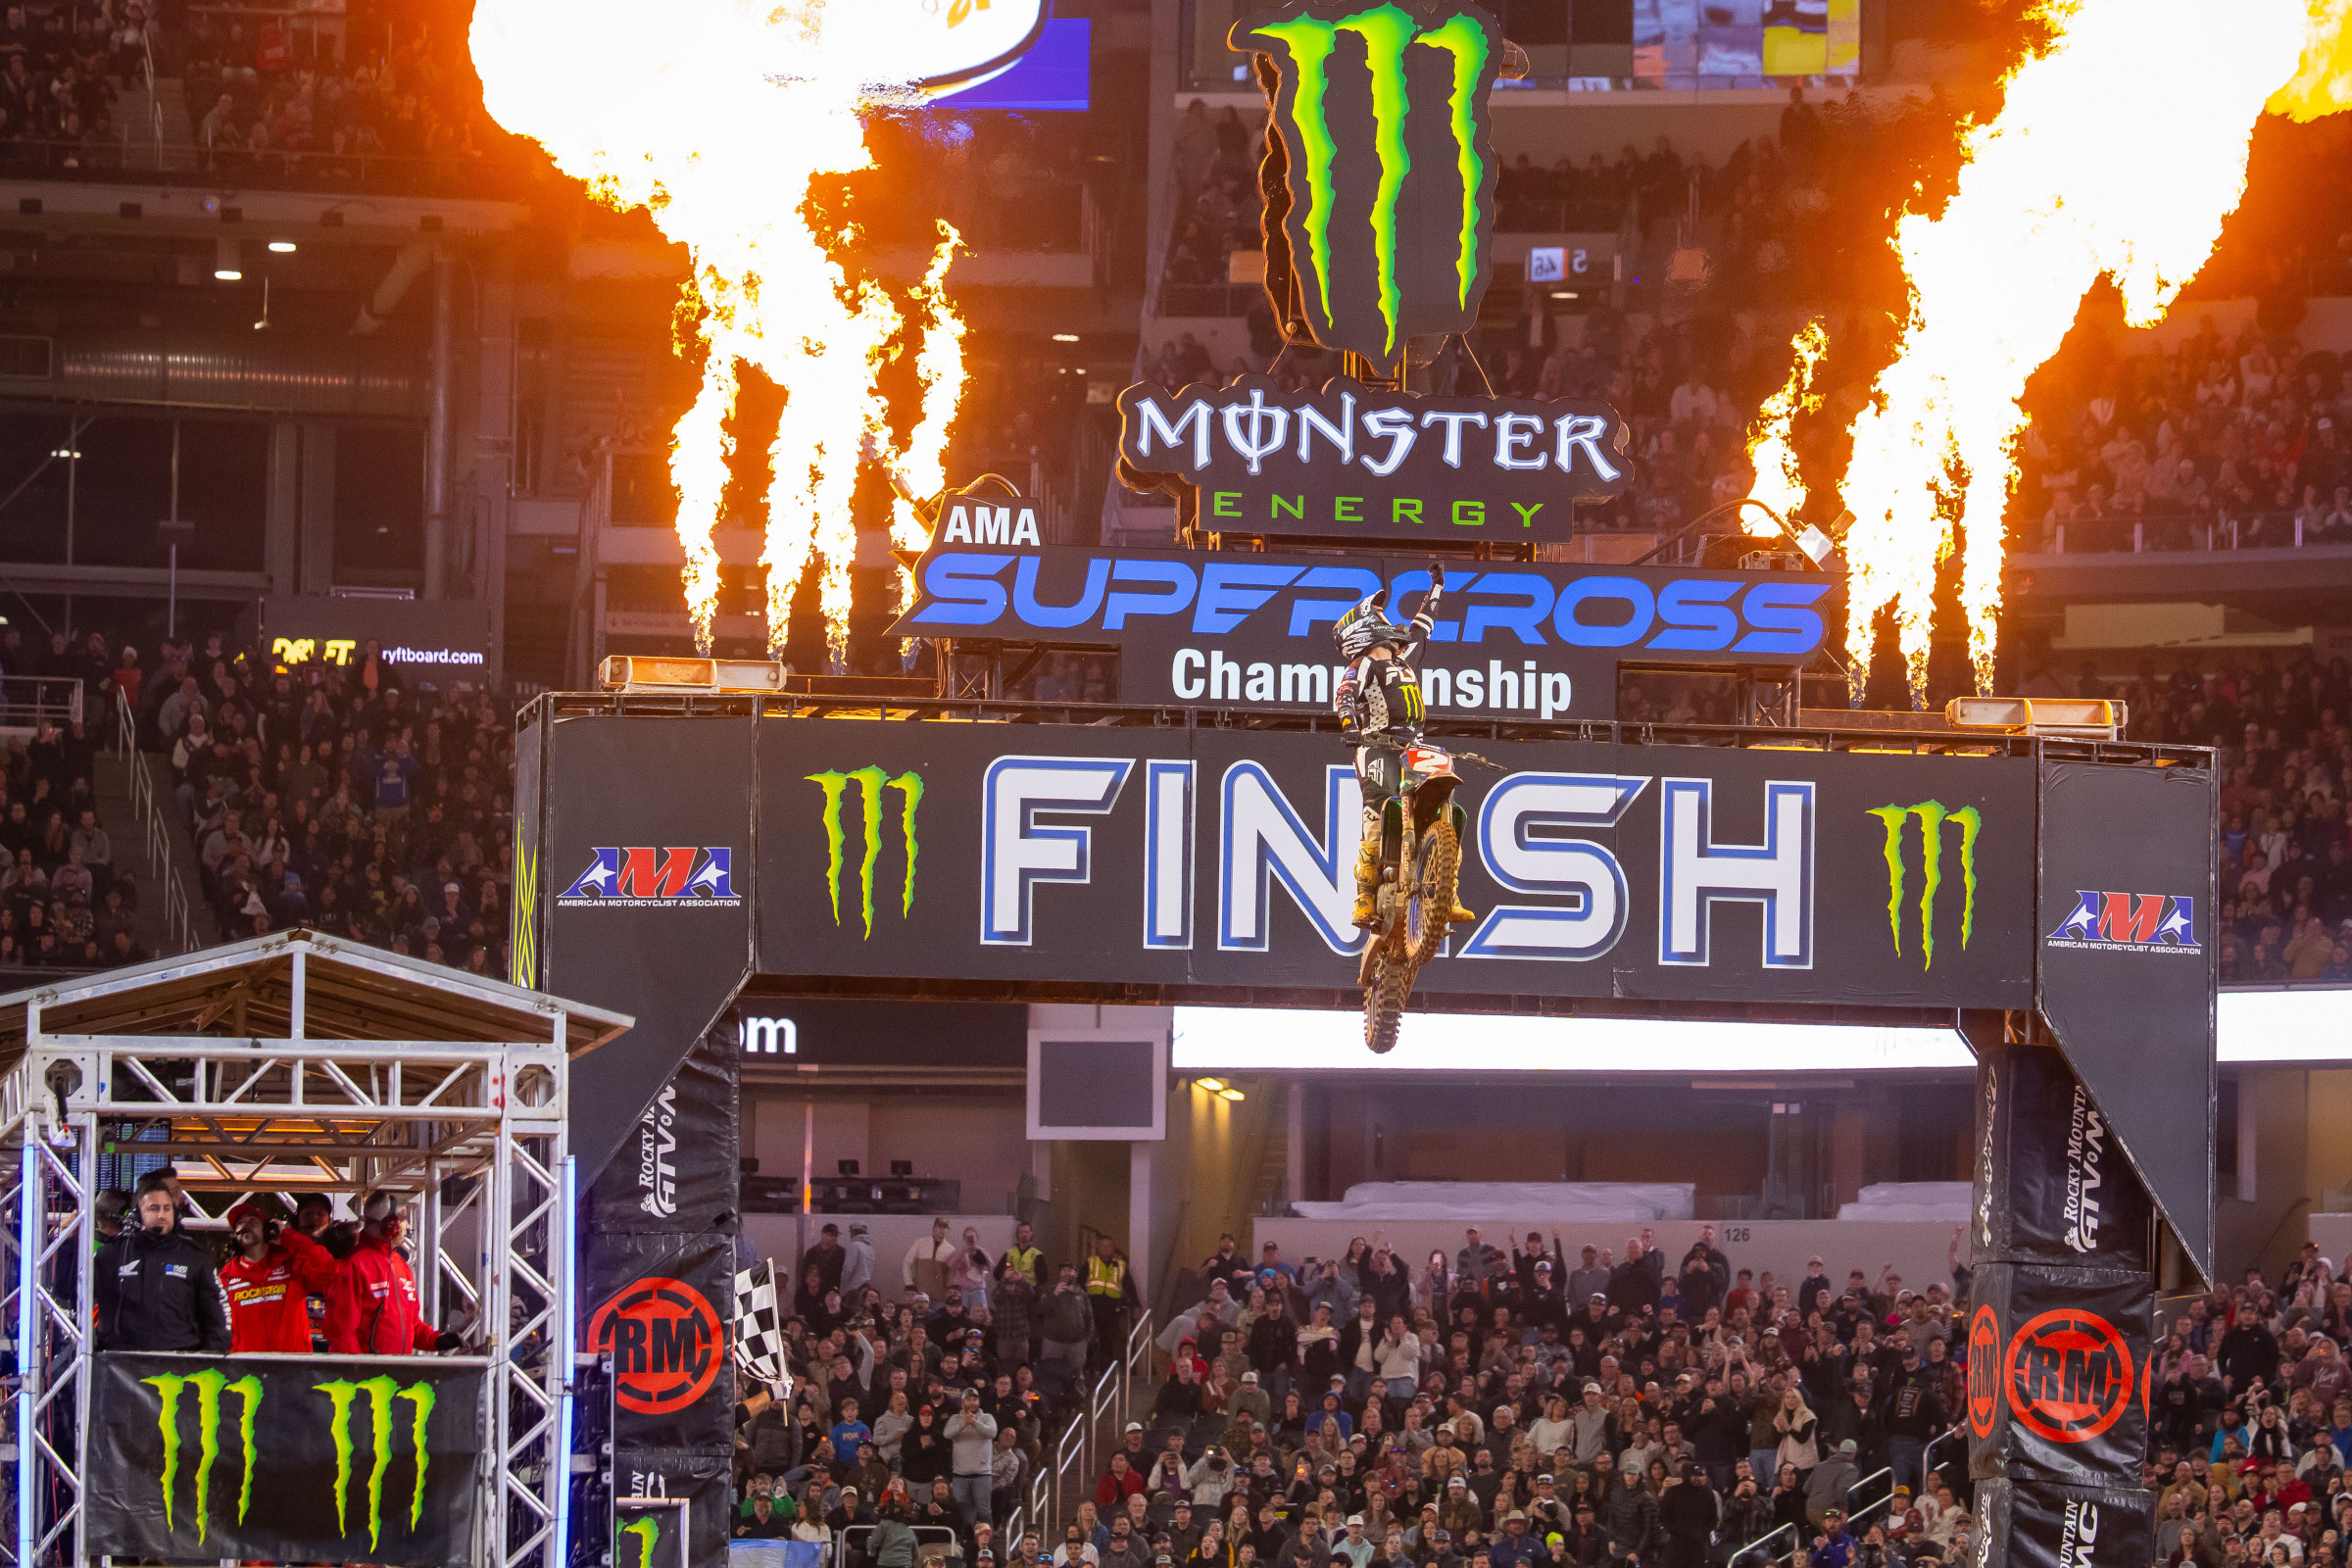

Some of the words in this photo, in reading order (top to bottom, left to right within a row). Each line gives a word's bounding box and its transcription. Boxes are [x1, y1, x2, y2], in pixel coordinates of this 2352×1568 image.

[1135, 388, 1622, 483] MONSTER
[944, 505, 1041, 547] AMA
[1213, 491, 1544, 527] ENERGY
[1413, 750, 1448, 773] 2
[1364, 809, 1380, 822] FLY
[555, 846, 743, 899] AMA
[980, 755, 1816, 970] FINSH
[558, 899, 606, 907] AMERICAN
[608, 899, 677, 907] MOTORCYCLIST
[679, 899, 741, 907] ASSOCIATION
[2045, 890, 2203, 948] AMA
[2047, 940, 2088, 950] AMERICAN
[2089, 942, 2149, 953] MOTORCYCLIST
[2150, 946, 2201, 956] ASSOCIATION
[2067, 1085, 2086, 1163] MOUNTA
[639, 1128, 654, 1190] ROCKY
[2063, 1163, 2081, 1223] ROCKY
[1724, 1228, 1750, 1243] 126
[614, 1318, 697, 1374] RM
[2028, 1344, 2107, 1406] RM
